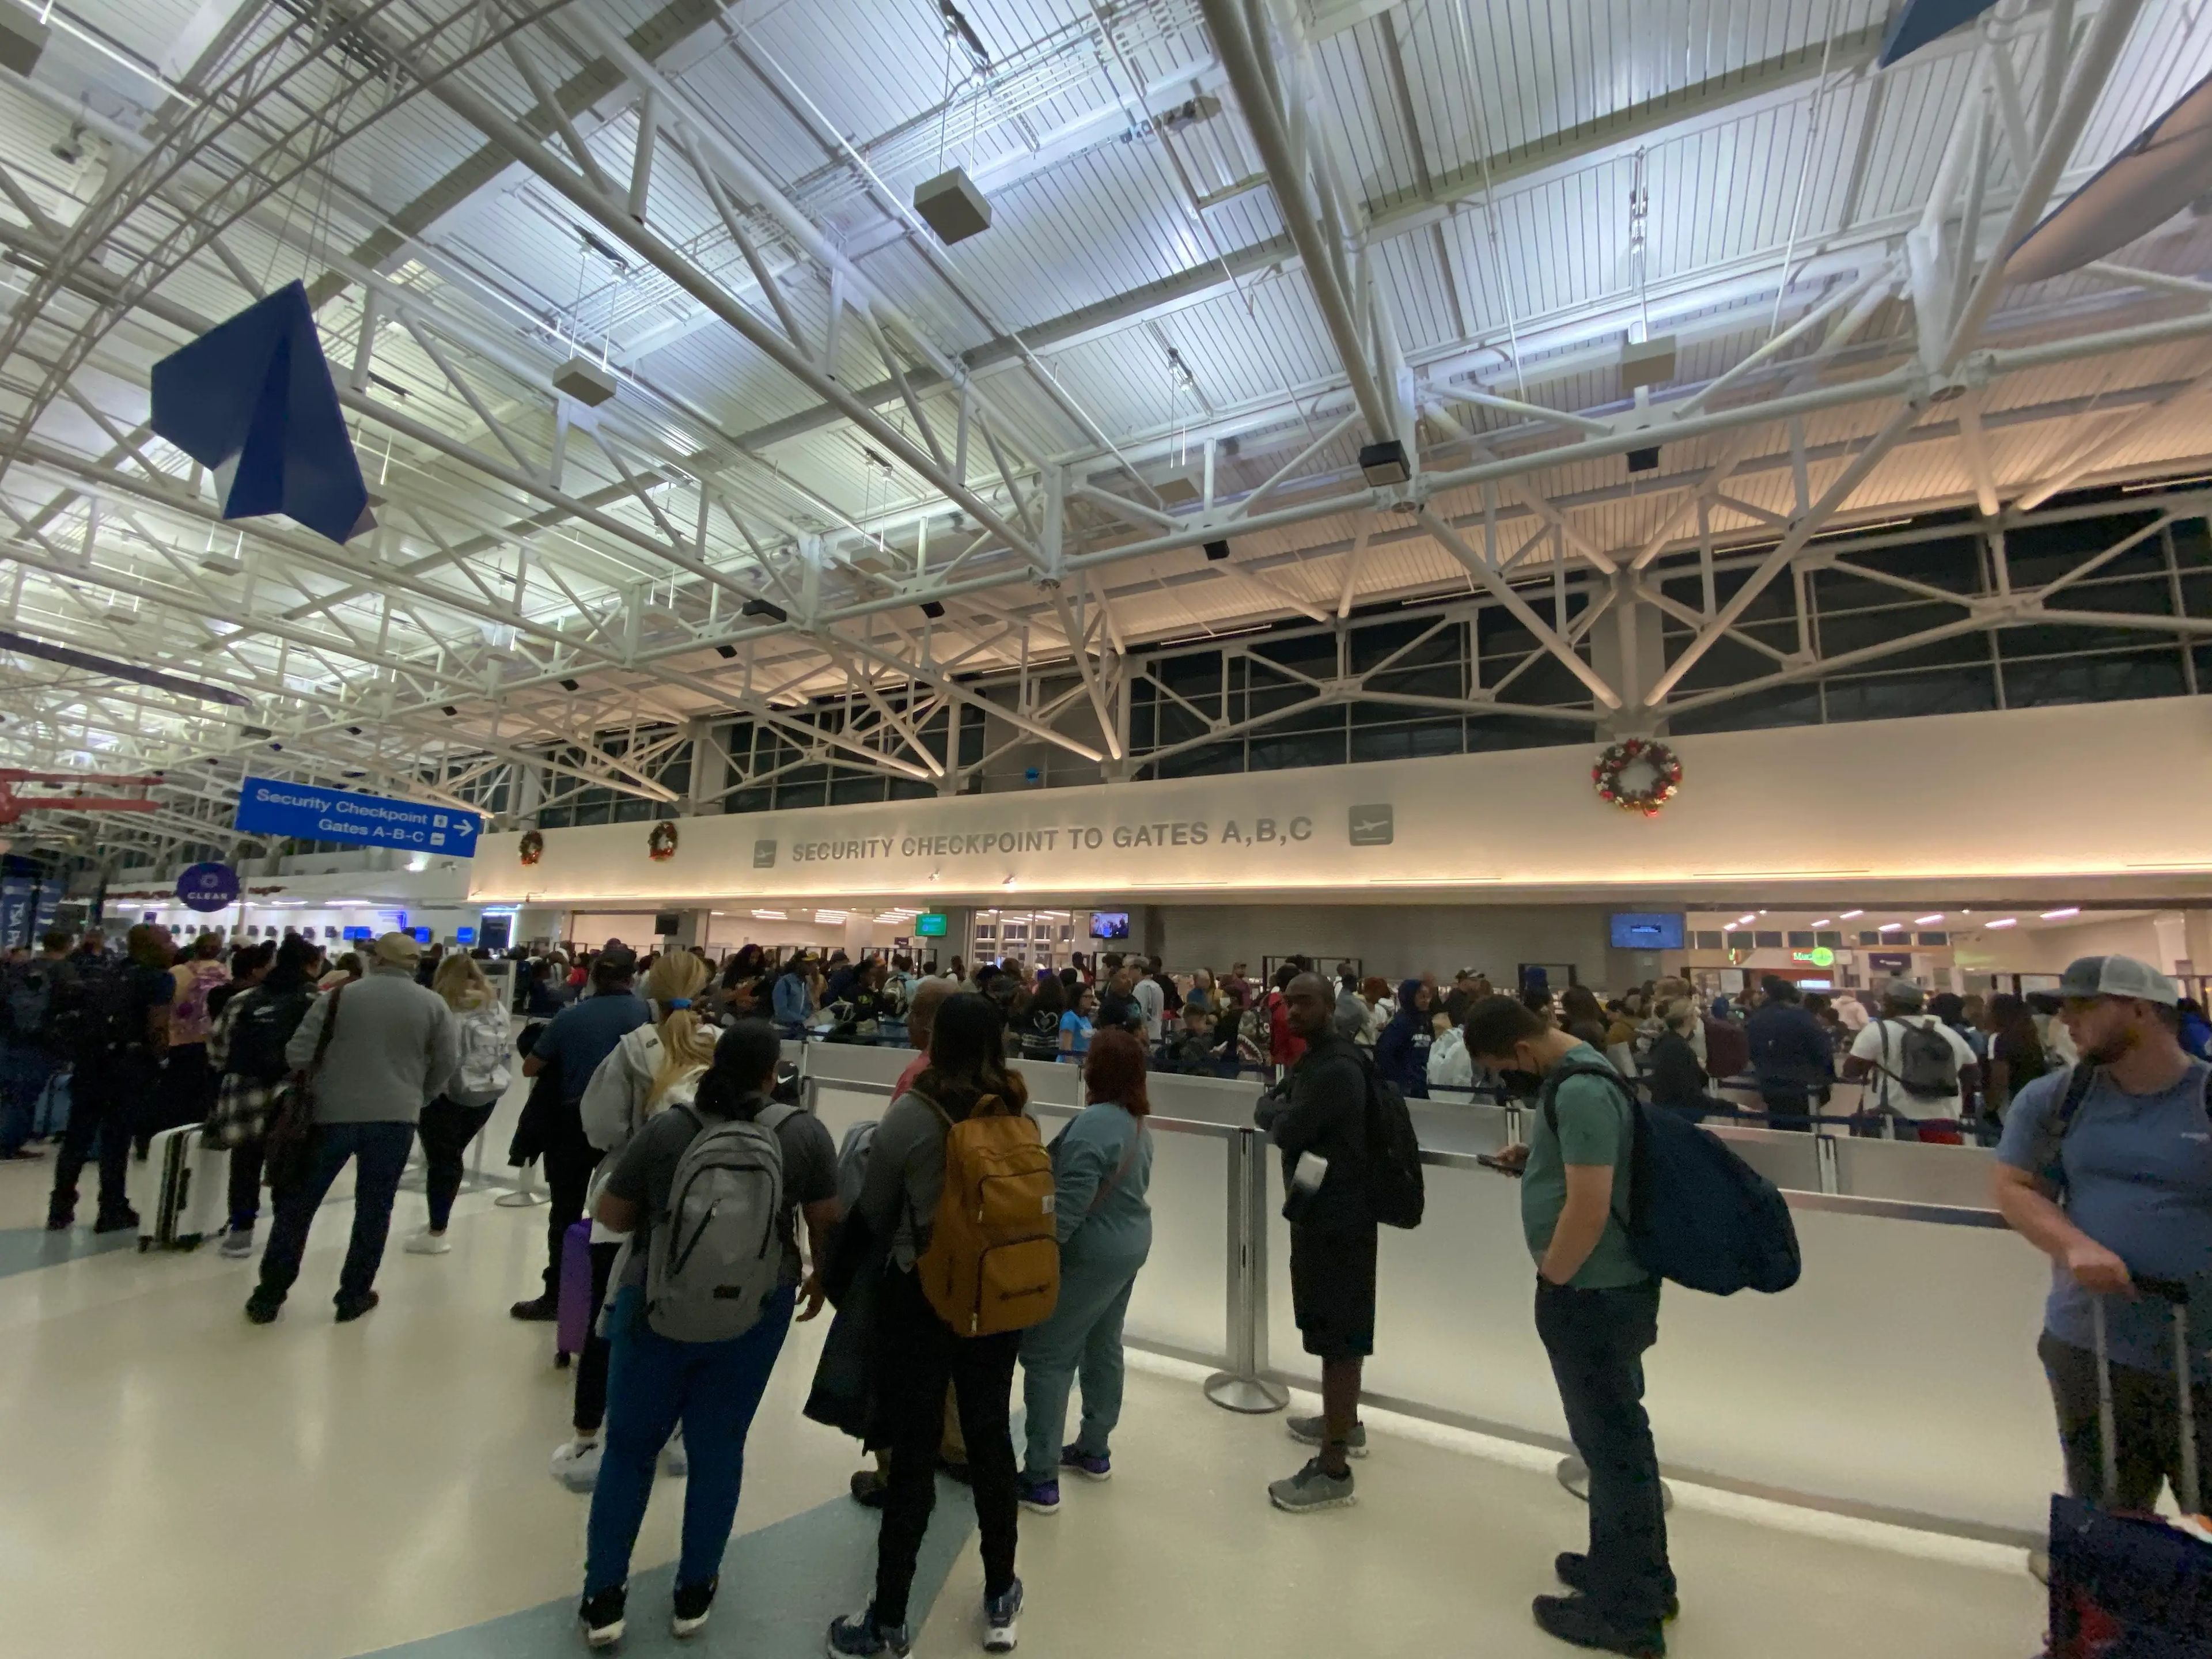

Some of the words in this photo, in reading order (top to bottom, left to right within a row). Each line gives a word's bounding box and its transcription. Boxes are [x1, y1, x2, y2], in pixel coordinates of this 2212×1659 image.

[256, 788, 332, 812] Security
[336, 801, 429, 824] Checkpoint
[318, 819, 369, 836] Gates
[372, 828, 425, 843] A-B-C
[792, 839, 893, 862] SECURITY
[901, 830, 1059, 856] CHECKPOINT
[1068, 827, 1103, 849] TO
[1113, 821, 1209, 848] GATES
[1221, 816, 1312, 846] A,B,C
